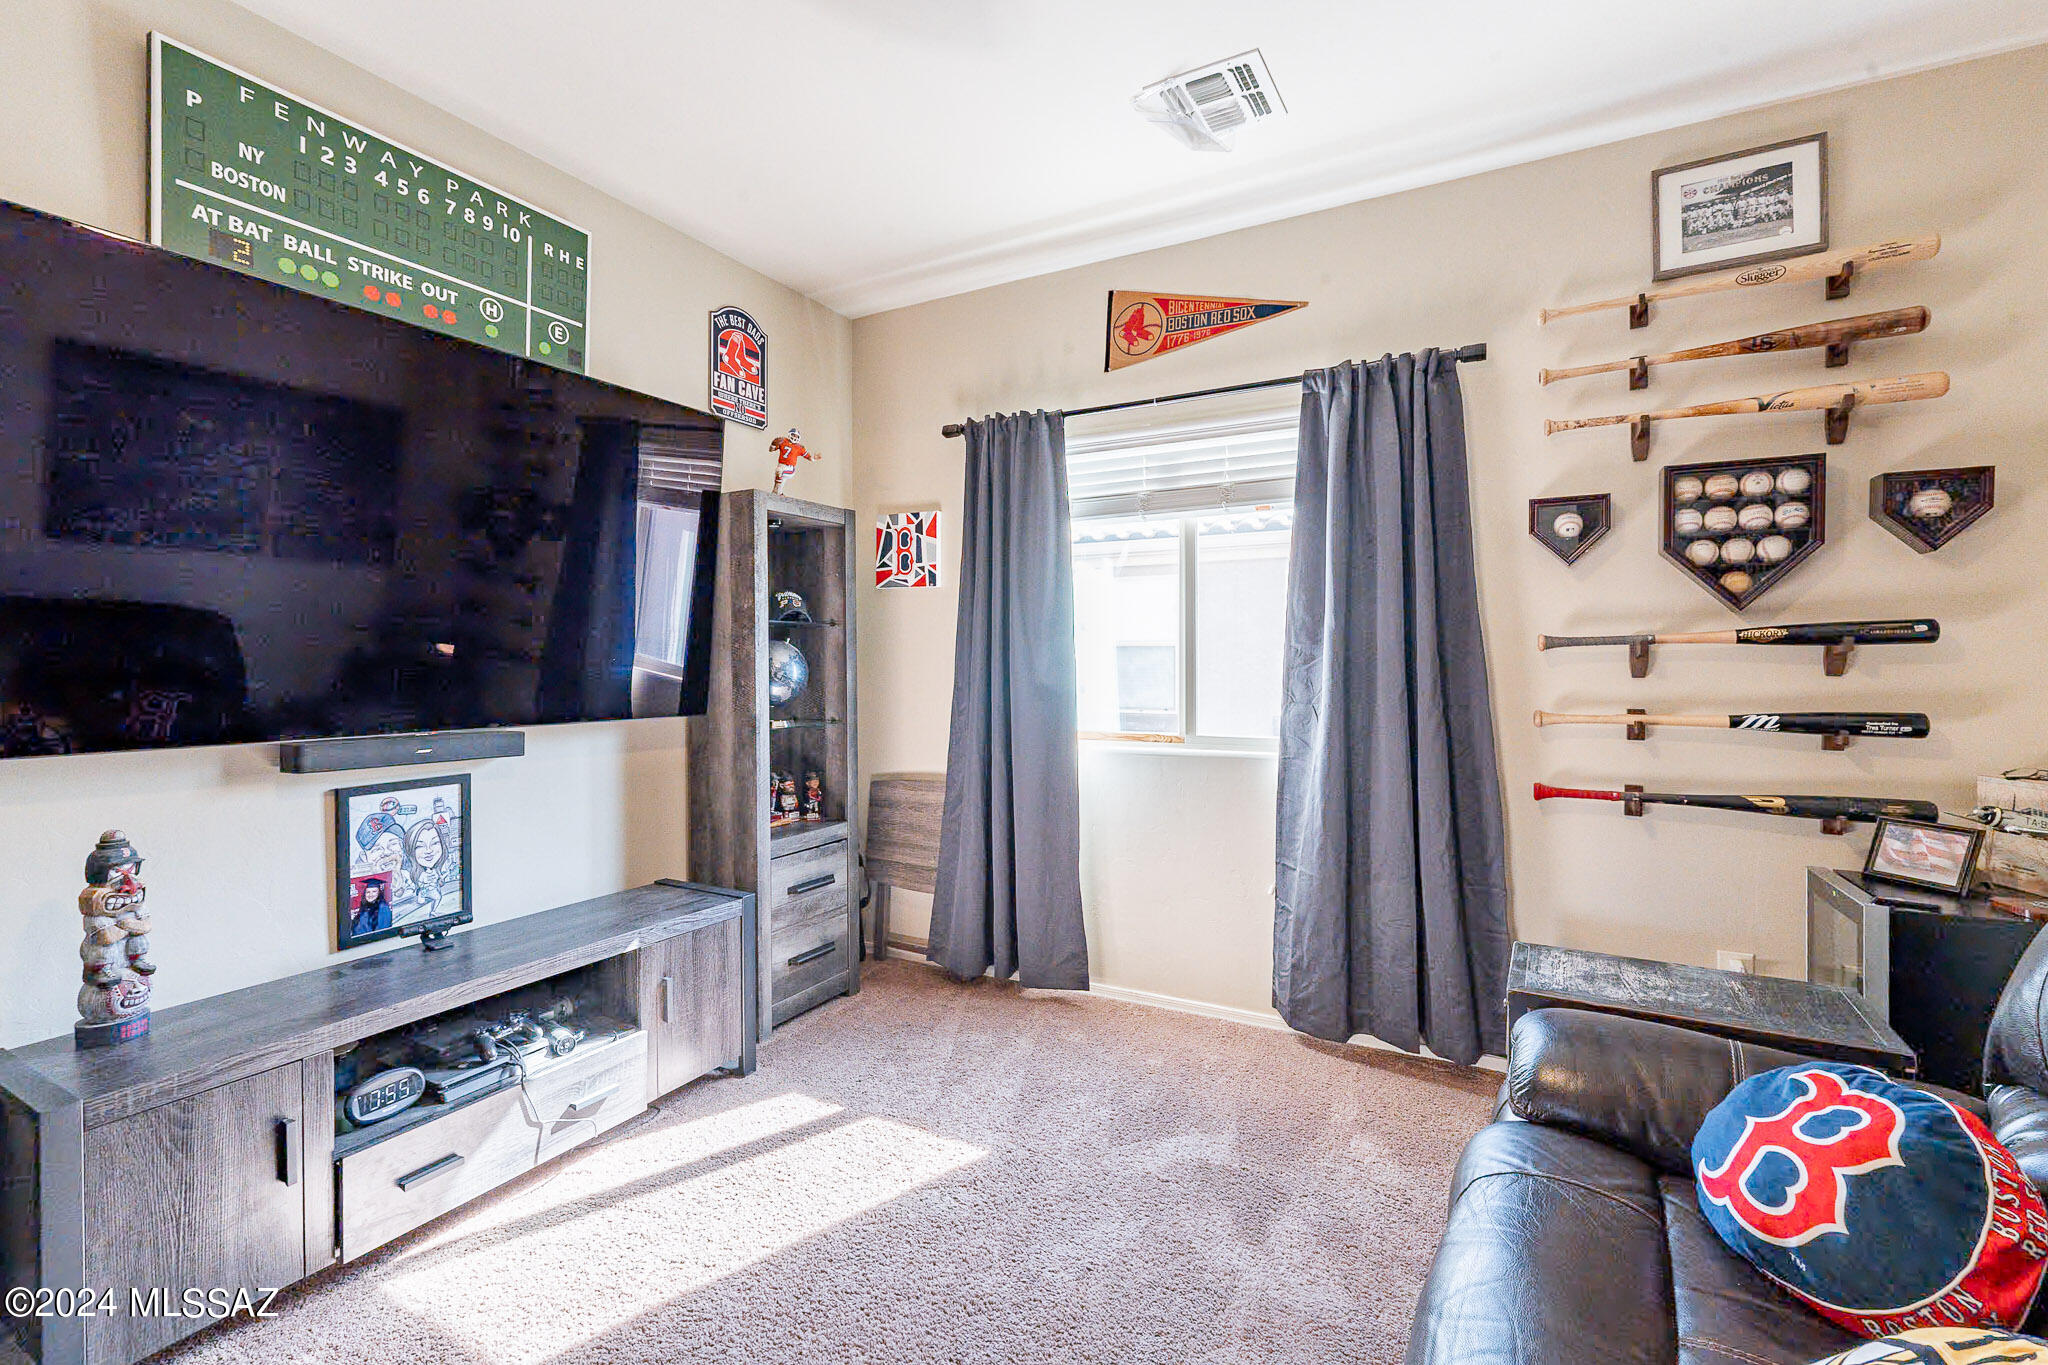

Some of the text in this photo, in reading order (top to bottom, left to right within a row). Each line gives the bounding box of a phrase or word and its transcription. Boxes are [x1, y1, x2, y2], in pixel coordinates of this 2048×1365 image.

[186, 89, 202, 107] P
[238, 141, 265, 165] NY
[210, 161, 286, 203] BOSTON
[299, 136, 521, 242] 1 2 3 4 5 6 7 8 9 10
[191, 204, 459, 305] AT BAT BALL STRIKE OUT
[232, 238, 250, 266] 2
[544, 242, 585, 270] R H E
[1741, 266, 1781, 284] Slugger
[485, 301, 498, 318] H
[1168, 300, 1225, 315] BICENTENNIAL
[1168, 306, 1257, 331] BOSTON RED SOX
[554, 325, 563, 340] E
[714, 314, 765, 346] THE BEST DADS
[713, 370, 765, 405] FAN CAVE
[783, 446, 792, 459] 7
[1740, 629, 1788, 641] HICKORY
